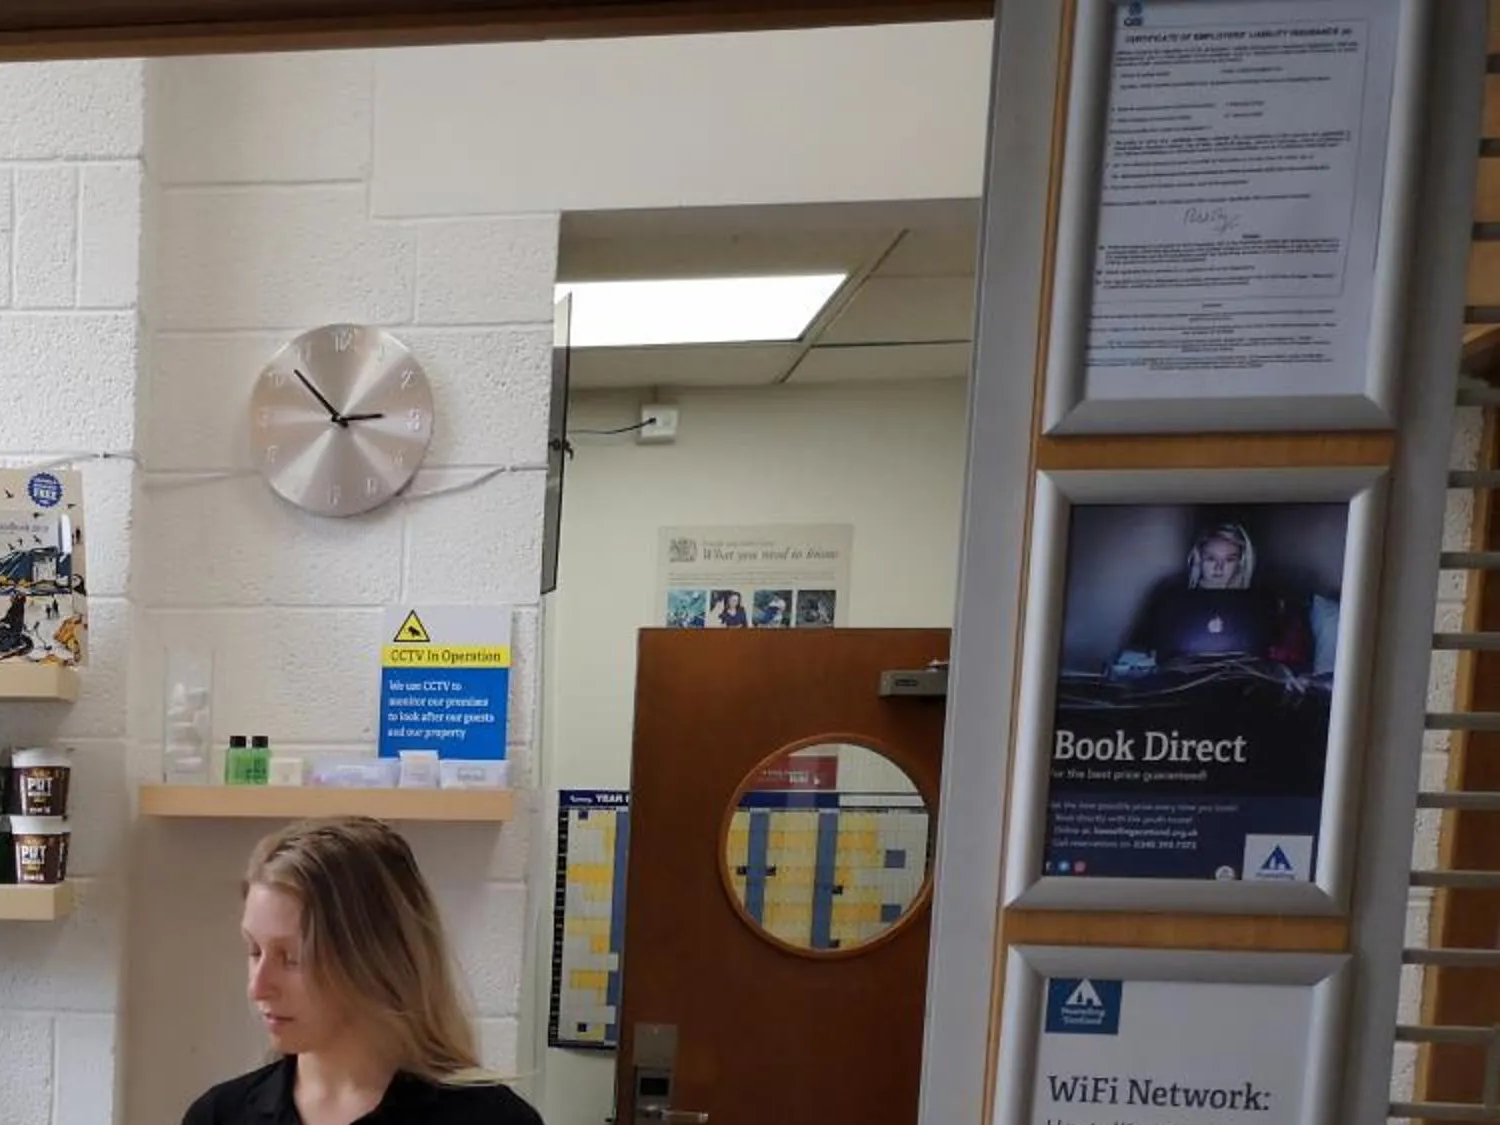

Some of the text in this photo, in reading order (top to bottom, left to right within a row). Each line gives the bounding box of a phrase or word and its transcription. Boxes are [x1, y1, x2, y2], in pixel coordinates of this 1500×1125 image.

[390, 649, 501, 664] CCTV In Operation
[388, 680, 463, 691] We use CCTV to
[387, 713, 399, 722] to
[399, 712, 419, 722] look
[421, 712, 445, 723] after
[463, 713, 496, 725] guests
[387, 727, 405, 738] and
[423, 727, 468, 741] property
[1053, 730, 1247, 763] Book Direct
[1047, 1074, 1272, 1112] WiFi Network:
